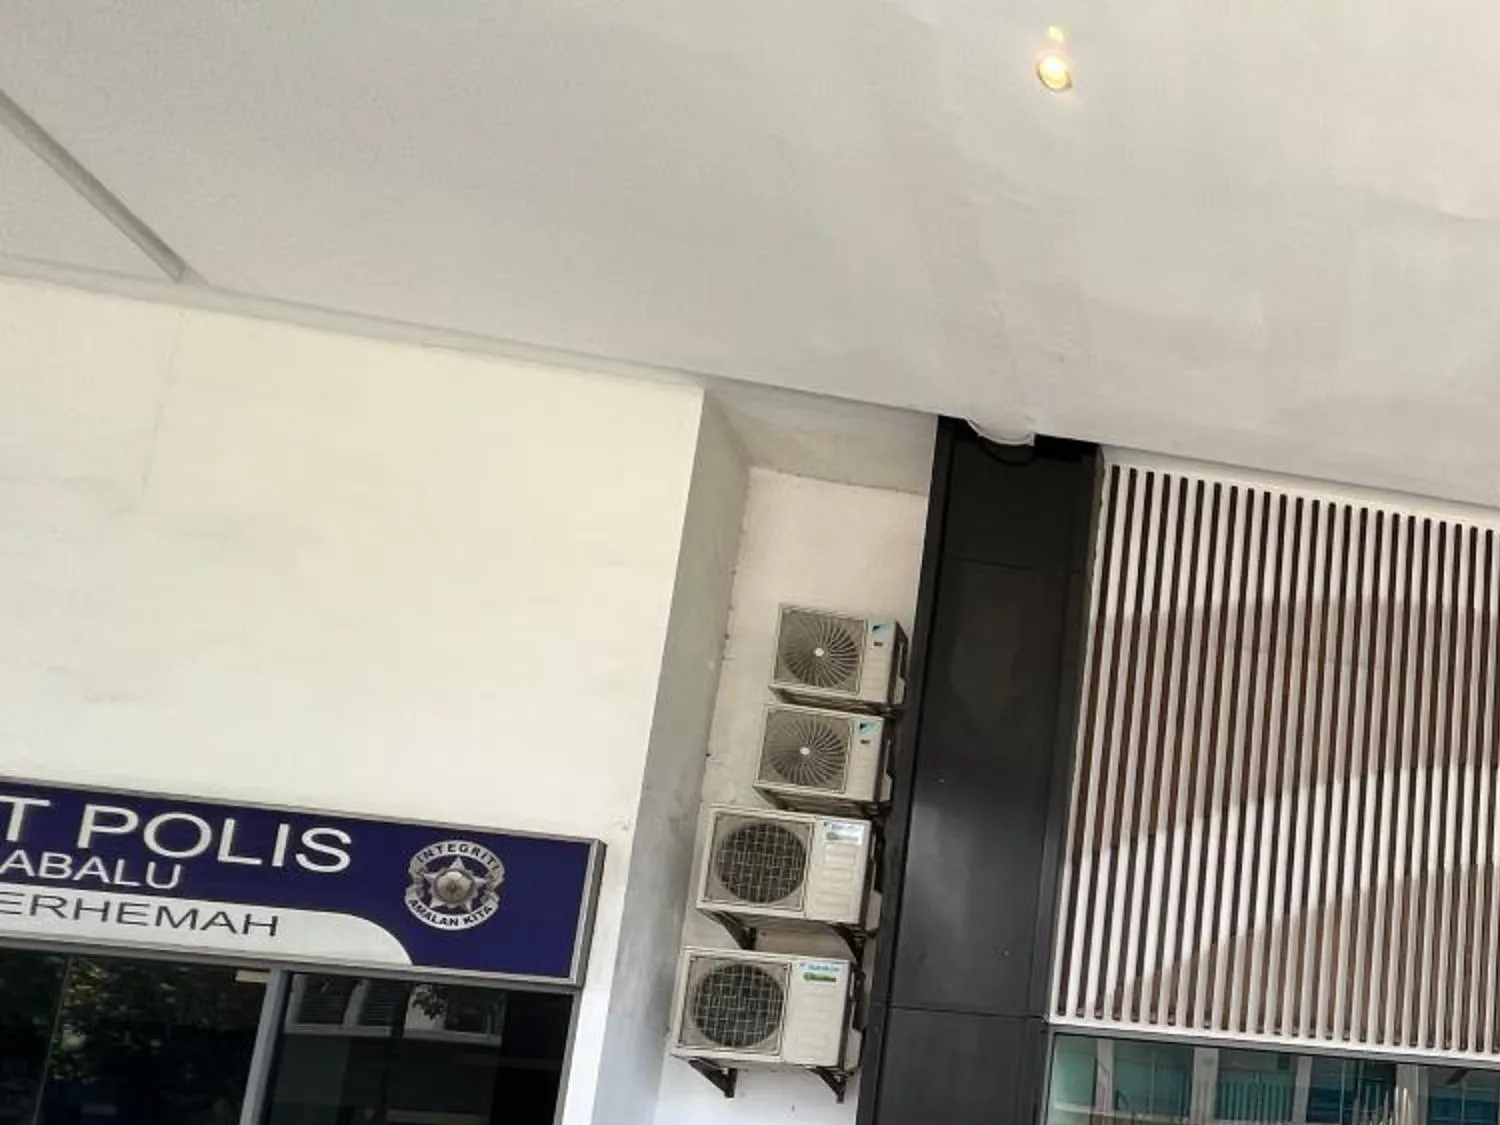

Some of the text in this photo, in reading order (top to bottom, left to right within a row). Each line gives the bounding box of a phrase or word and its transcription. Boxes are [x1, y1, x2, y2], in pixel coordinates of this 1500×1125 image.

[0, 795, 352, 873] T POLIS
[0, 849, 181, 889] ABALU
[407, 899, 493, 926] AMALAN KITA
